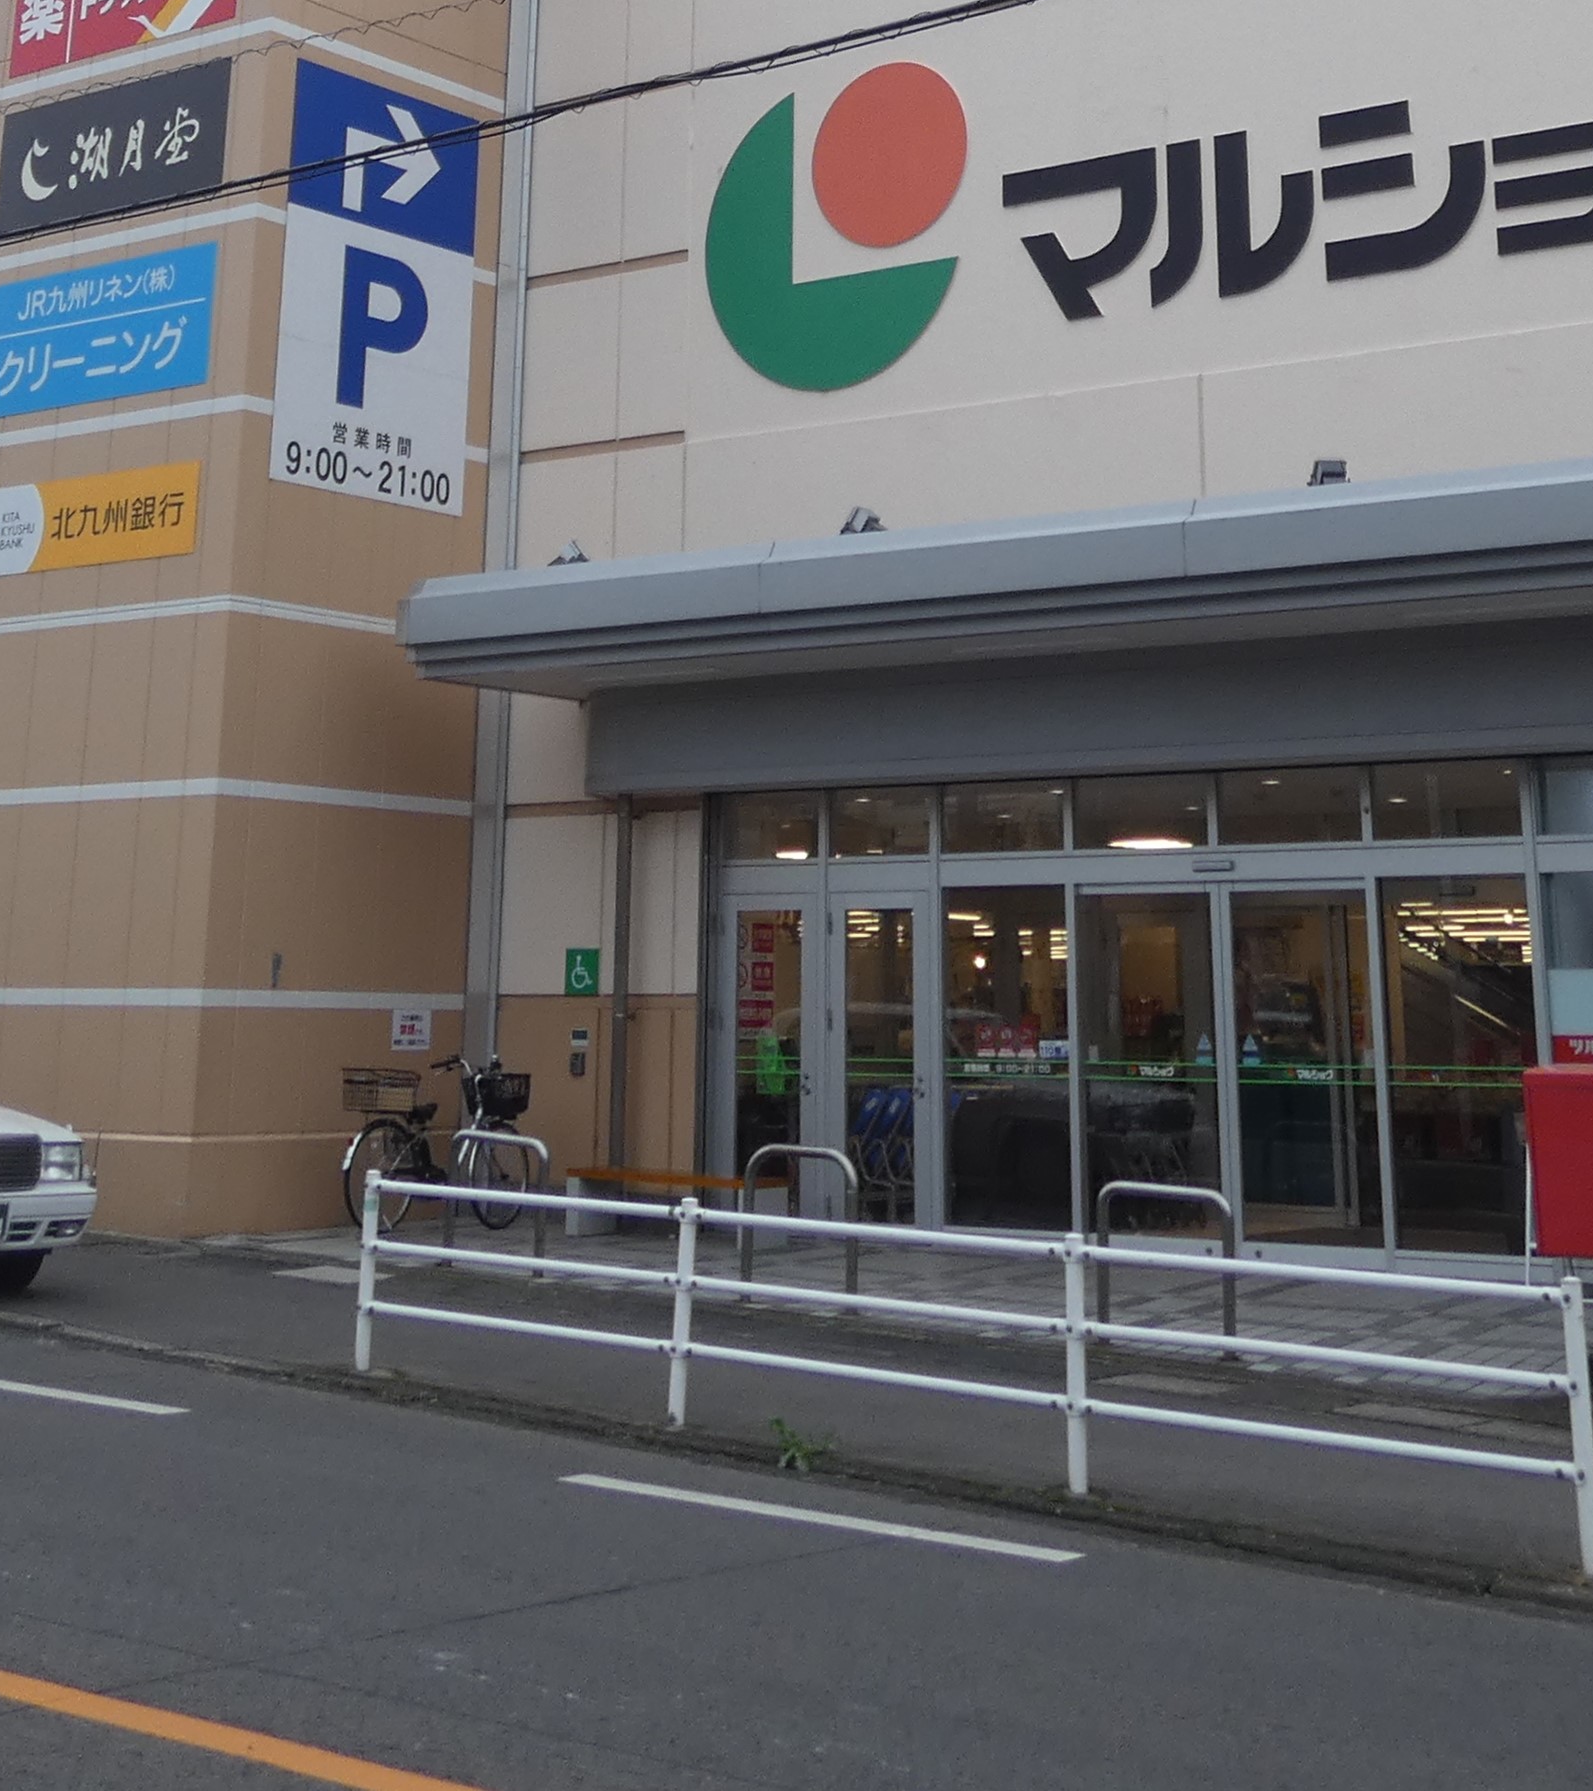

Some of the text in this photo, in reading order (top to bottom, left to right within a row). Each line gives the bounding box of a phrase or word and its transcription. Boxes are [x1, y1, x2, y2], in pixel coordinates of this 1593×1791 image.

[68, 106, 200, 190] 湖月堂
[335, 244, 429, 409] P
[332, 421, 412, 459] 営業時間
[2, 512, 21, 524] KITA
[50, 492, 185, 541] 北九州銀行
[0, 537, 24, 552] BANK
